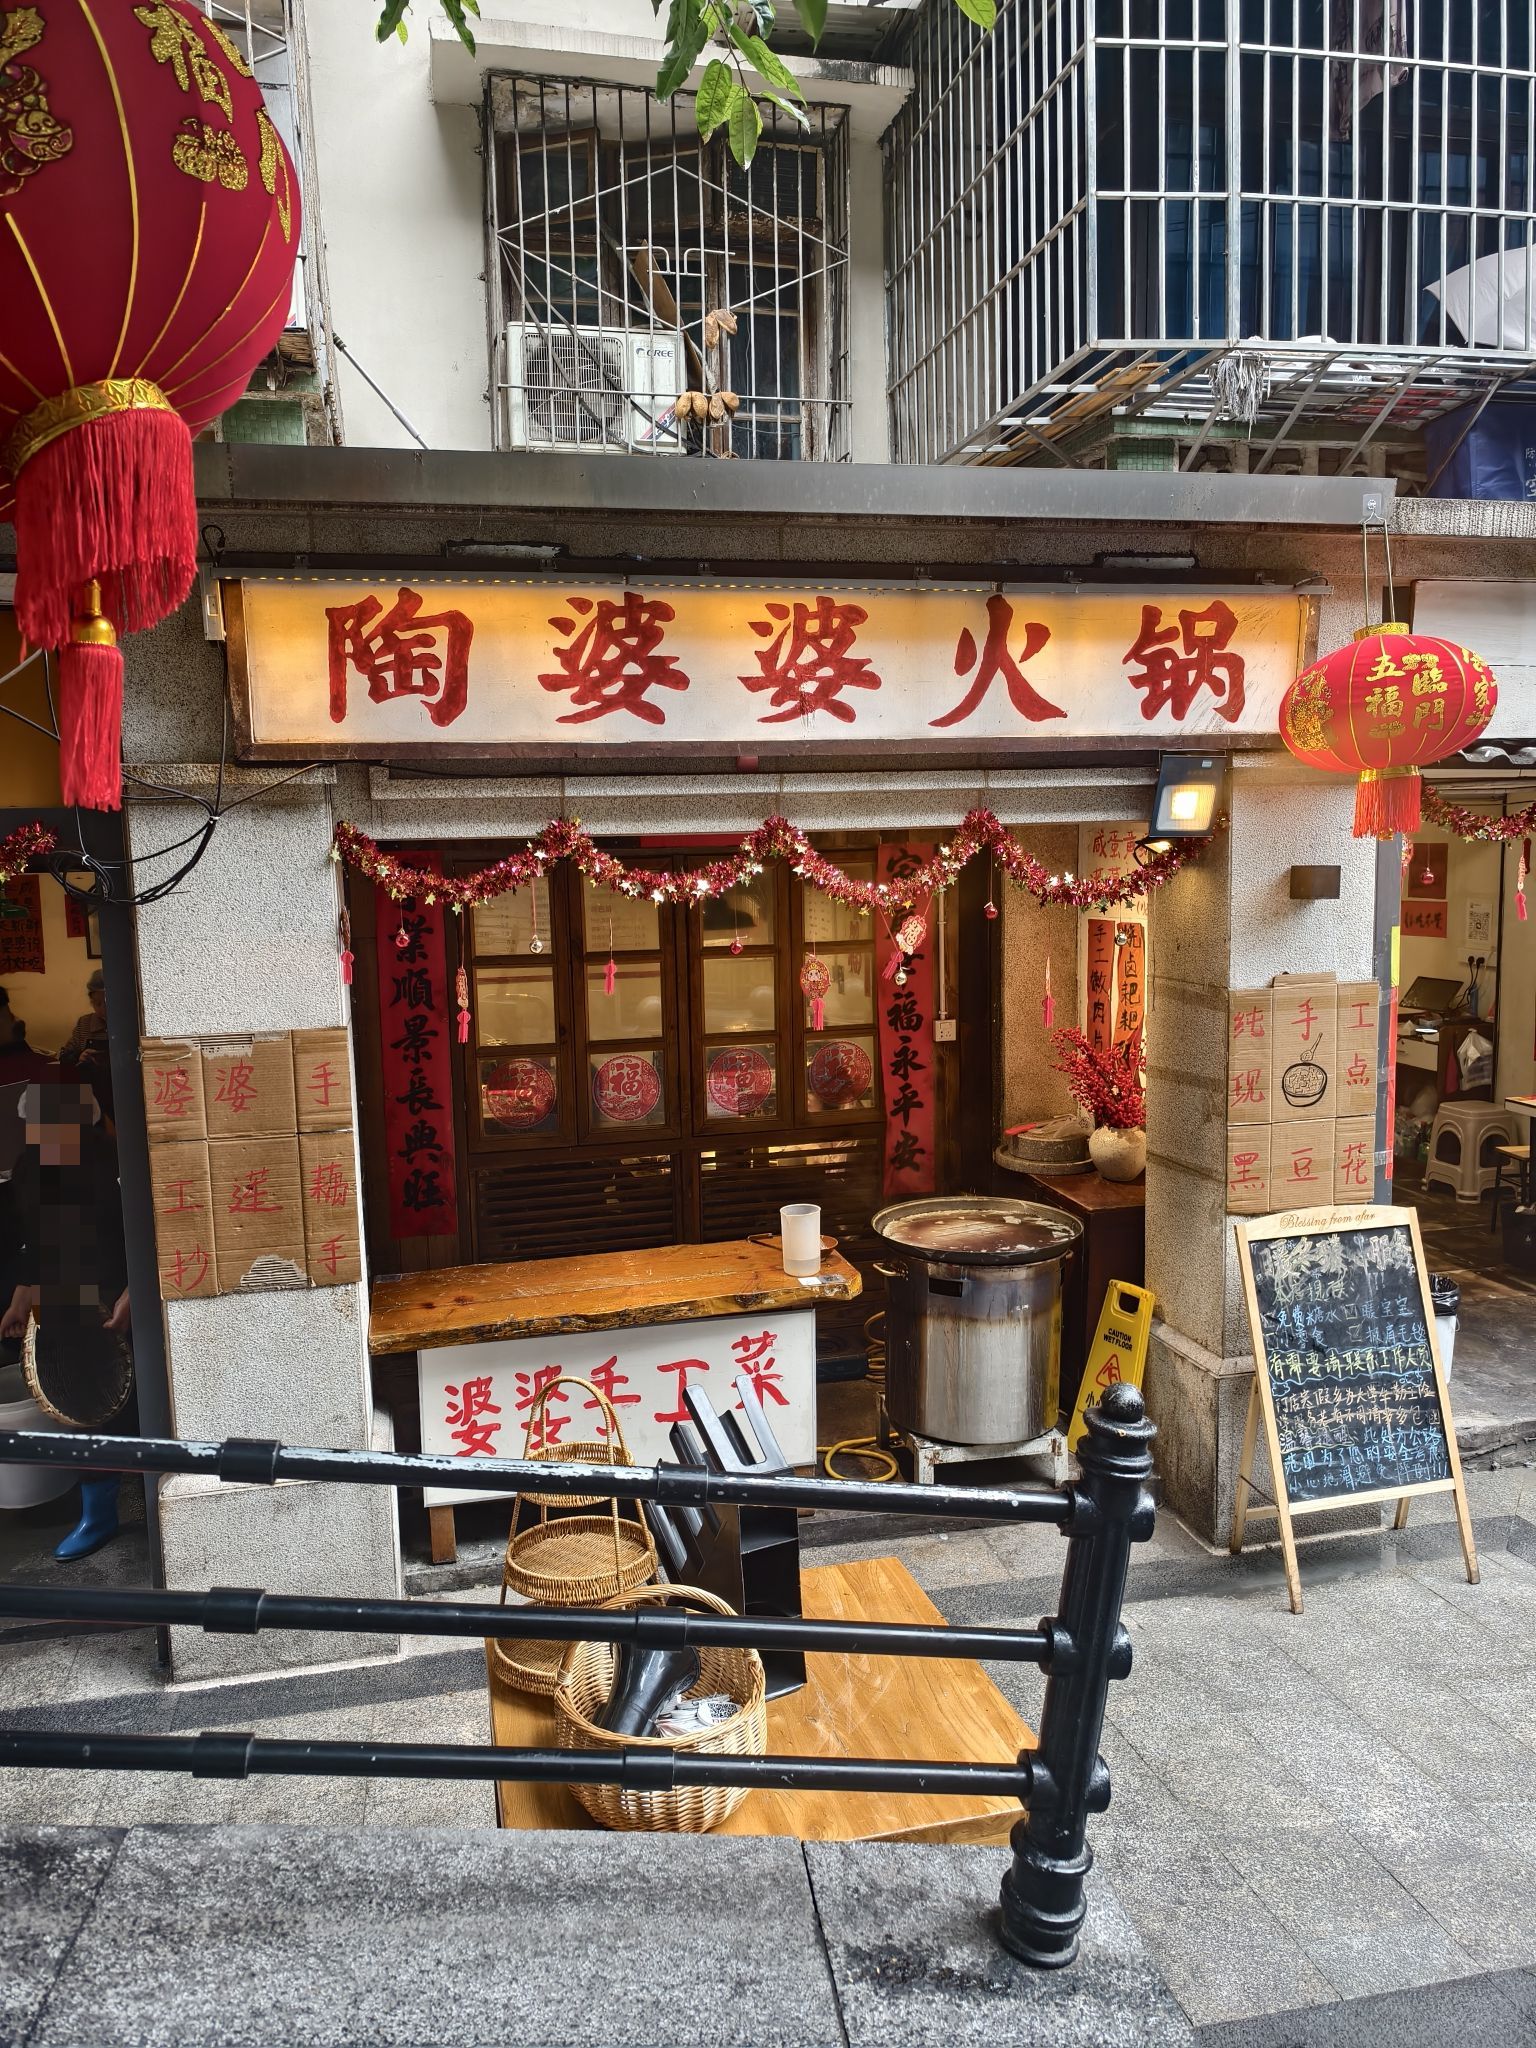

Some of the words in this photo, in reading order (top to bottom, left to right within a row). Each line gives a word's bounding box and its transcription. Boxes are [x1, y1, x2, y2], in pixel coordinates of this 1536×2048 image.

[646, 349, 674, 358] GREE
[325, 587, 1246, 727] 陶婆婆火锅
[387, 862, 446, 1210] 業順景長興旺
[1232, 996, 1375, 1041] 纯手工
[153, 1058, 341, 1115] 婆婆手
[1229, 1144, 1368, 1190] 黑豆花
[1279, 1213, 1327, 1230] Blessing
[1325, 1212, 1352, 1230] from
[1355, 1210, 1376, 1227] afar
[1103, 1333, 1116, 1345] WET
[1115, 1338, 1133, 1351] FLOOR
[1107, 1328, 1132, 1343] CAUTION
